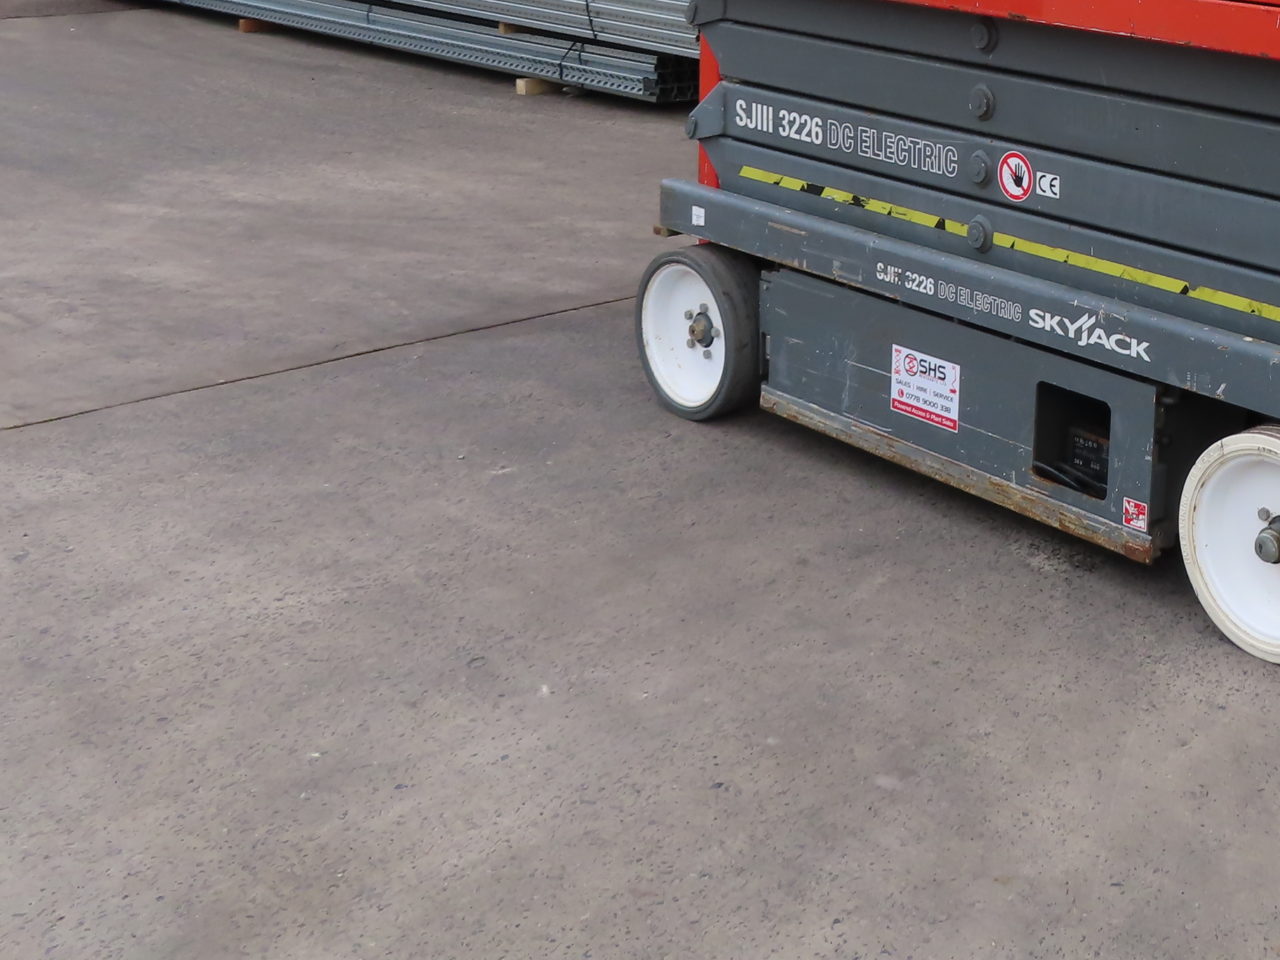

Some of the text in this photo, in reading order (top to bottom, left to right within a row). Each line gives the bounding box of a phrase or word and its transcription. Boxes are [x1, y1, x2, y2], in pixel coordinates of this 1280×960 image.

[735, 99, 958, 177] SJIII 3226 DC ELECTRIC
[904, 271, 935, 295] 3226
[937, 280, 956, 301] DC
[957, 286, 1022, 322] ELECTRIC
[1028, 308, 1151, 362] SKYJACK
[919, 358, 947, 381] SHS
